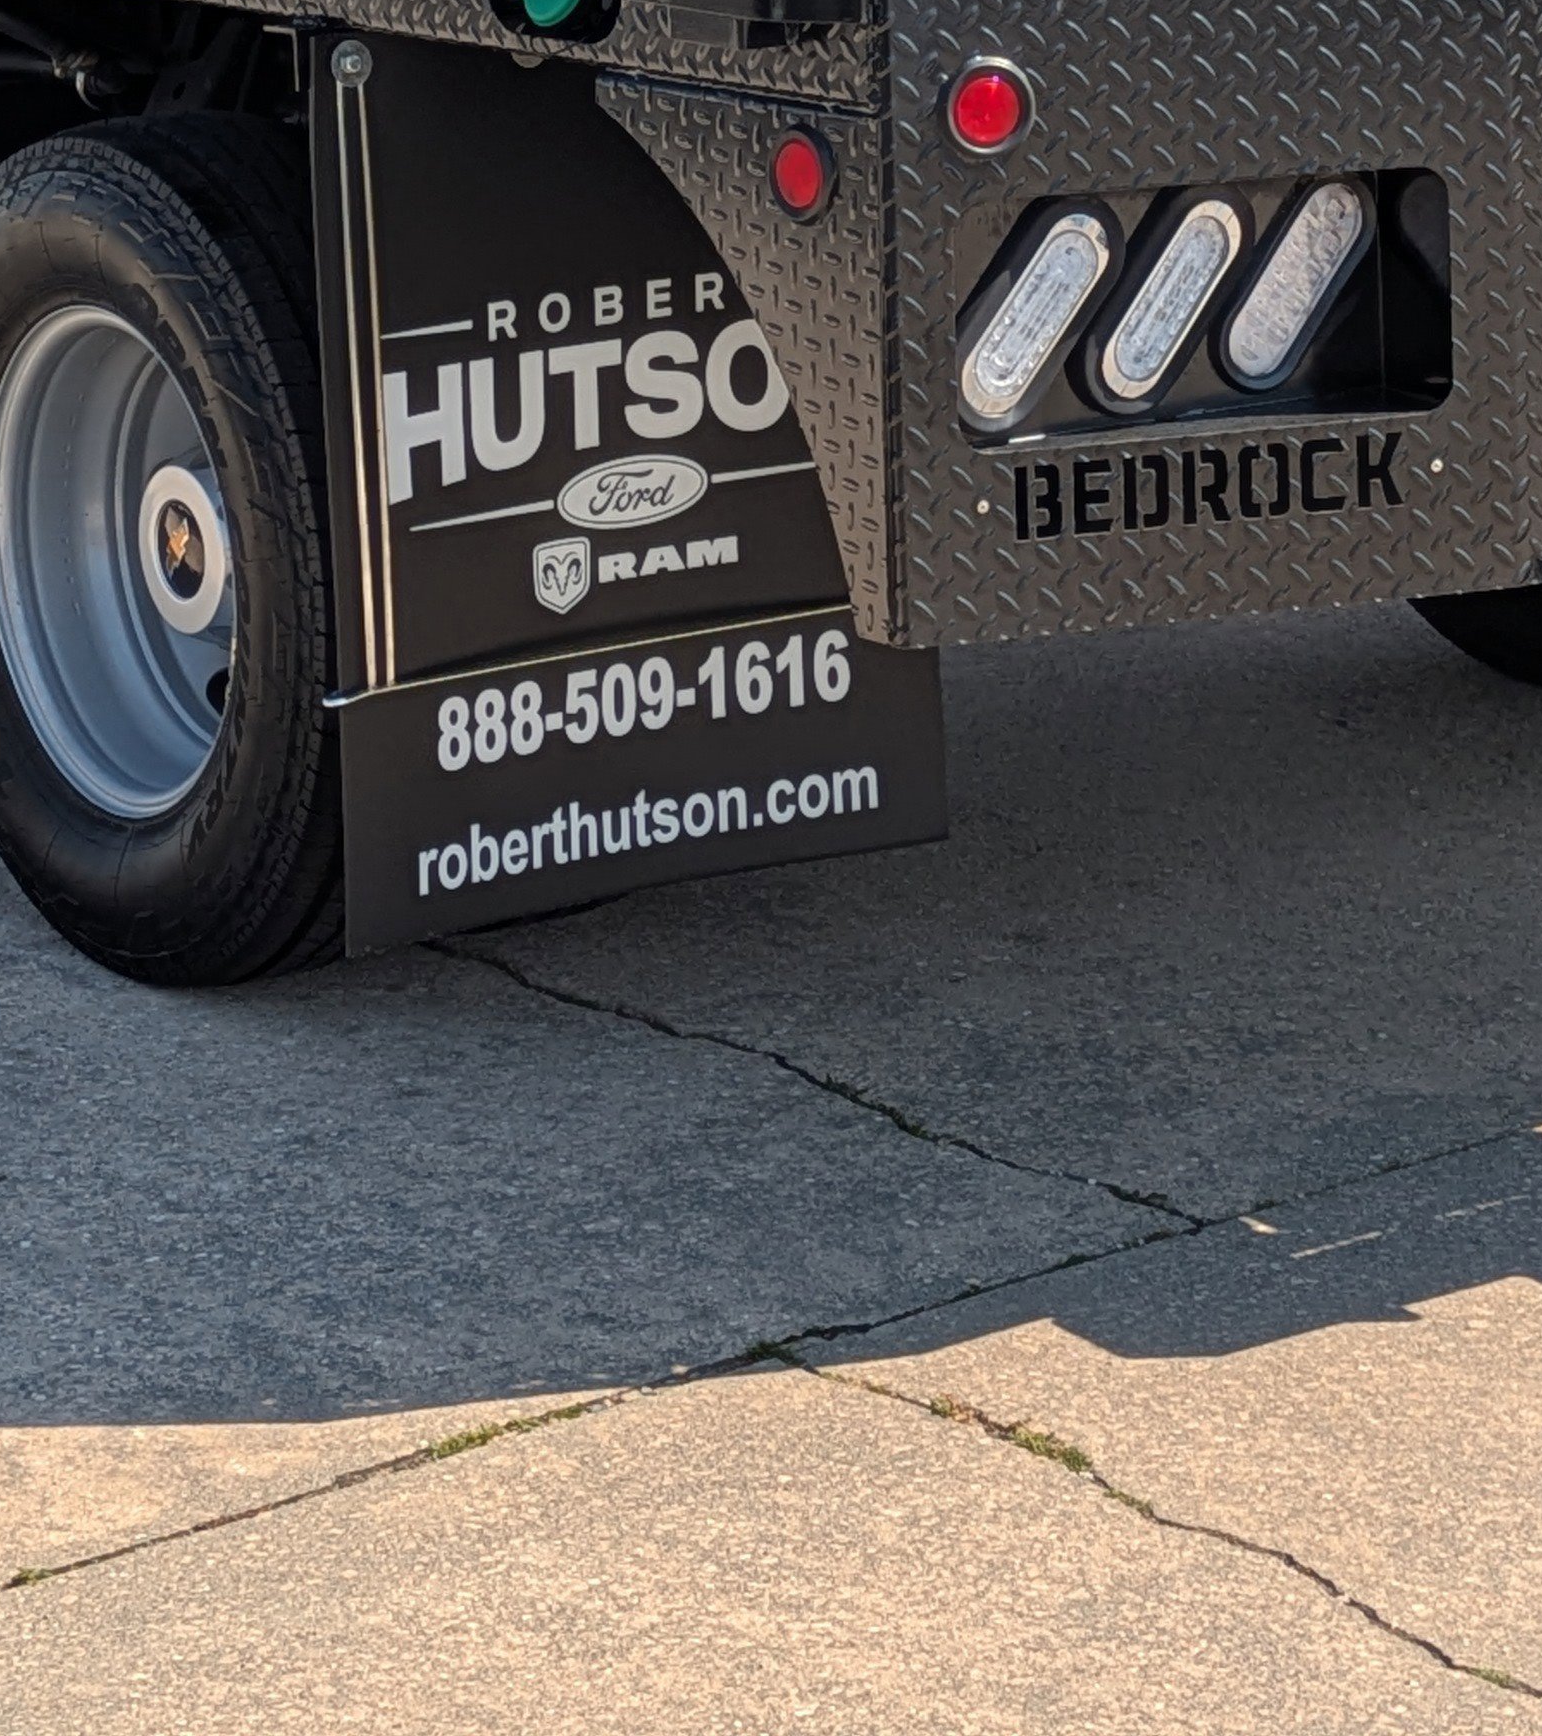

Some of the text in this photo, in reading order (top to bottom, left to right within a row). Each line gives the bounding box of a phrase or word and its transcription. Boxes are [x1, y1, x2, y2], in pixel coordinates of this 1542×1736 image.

[486, 271, 726, 342] ROBER
[381, 317, 791, 506] HUTSO
[589, 467, 674, 515] Ford
[1014, 431, 1405, 543] BEDROCK
[597, 535, 740, 583] RAM
[436, 629, 851, 773] 888-509-1616
[417, 764, 880, 897] roberthutson.com
